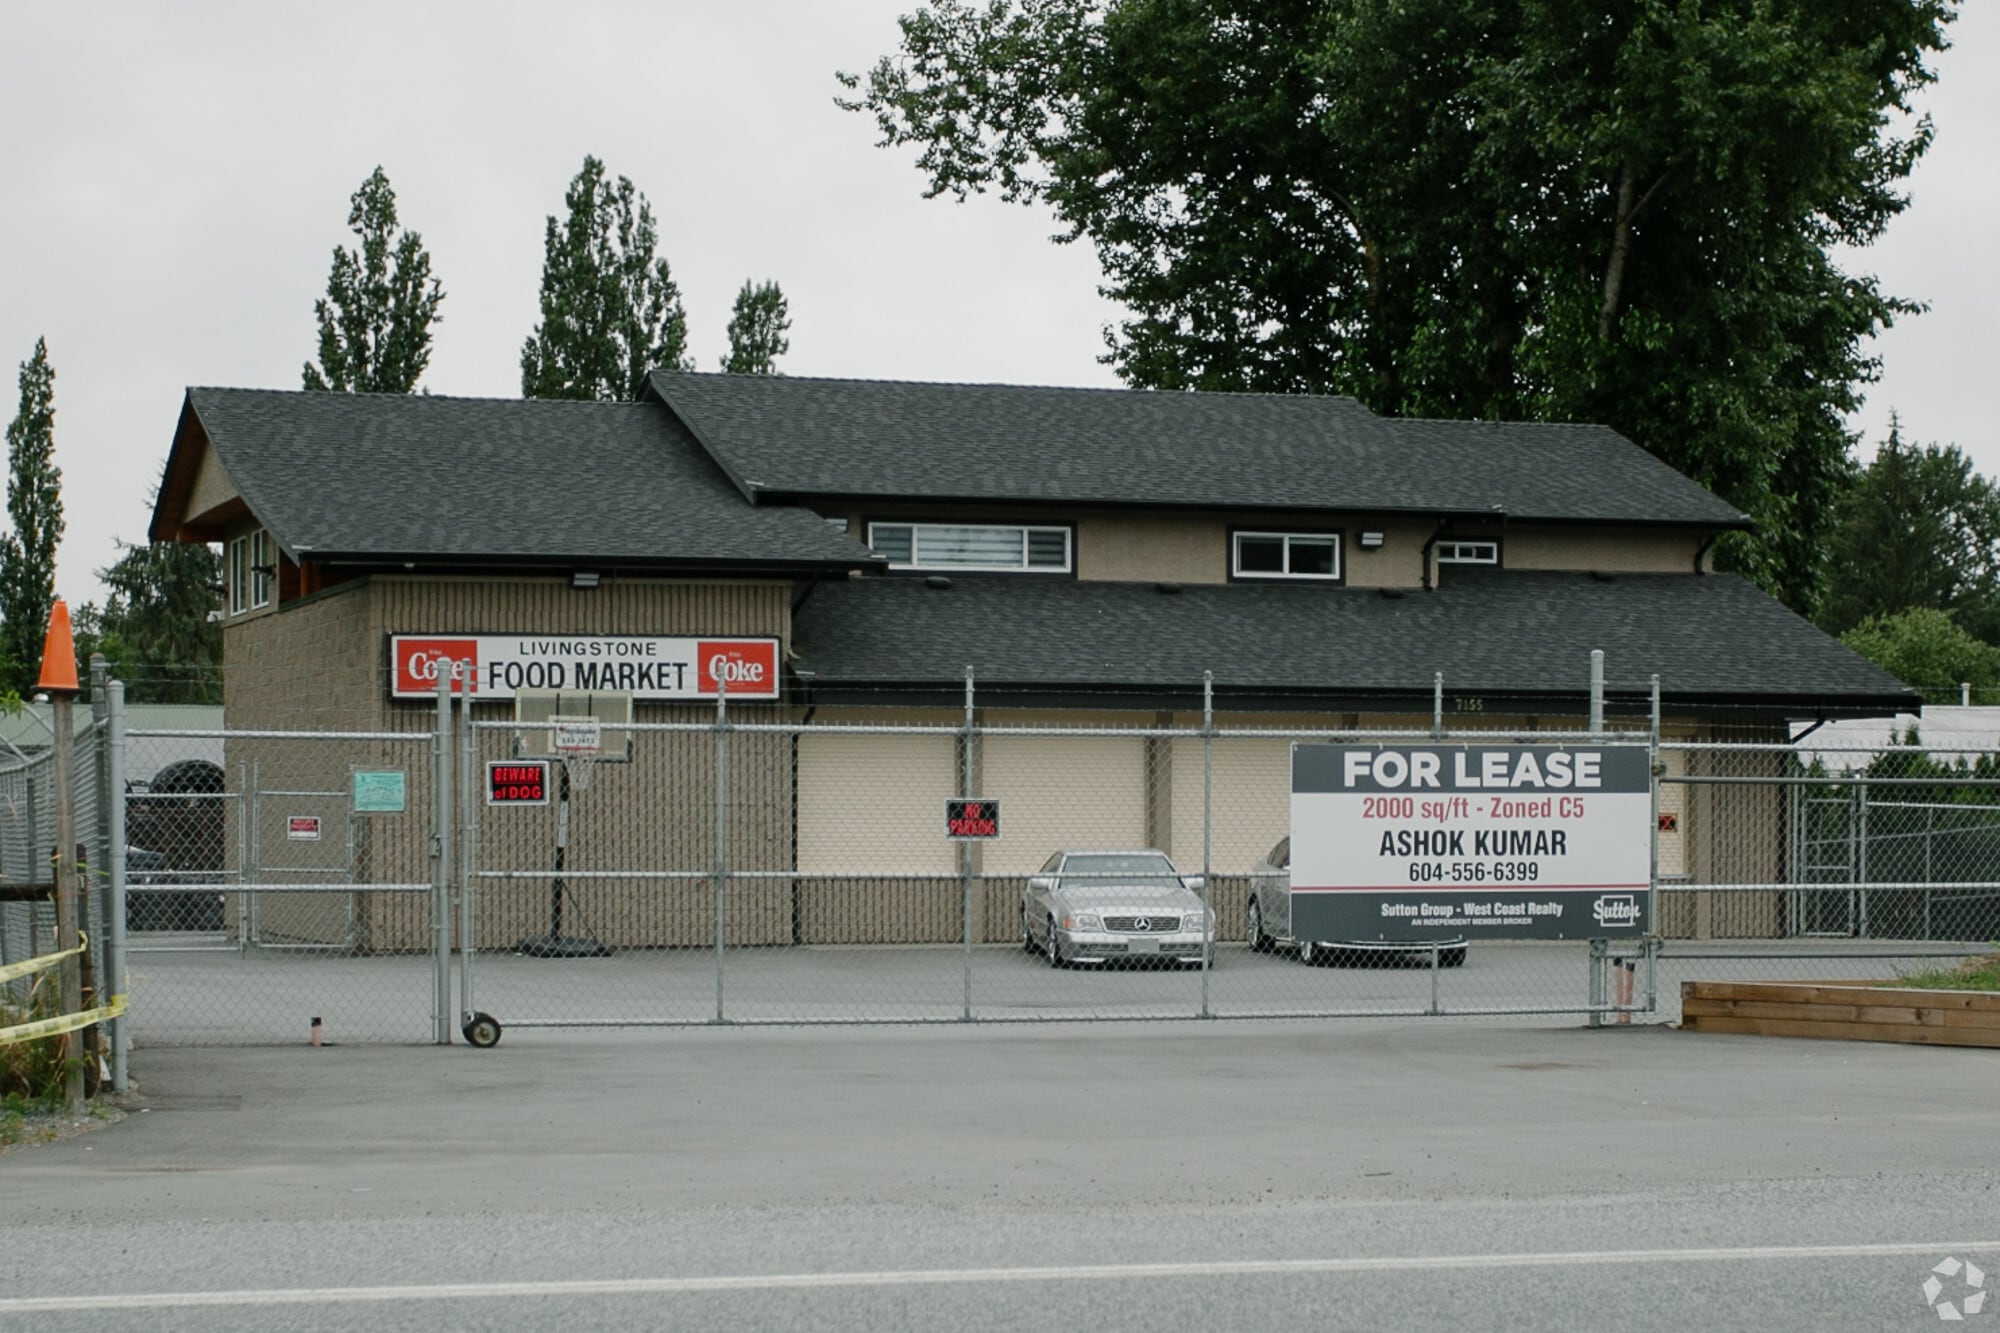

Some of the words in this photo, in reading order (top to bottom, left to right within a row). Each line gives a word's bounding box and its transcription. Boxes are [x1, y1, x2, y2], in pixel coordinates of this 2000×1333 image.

[519, 641, 657, 656] LIVINGSTONE
[489, 661, 566, 690] FOOD
[574, 661, 689, 690] MARKET
[708, 653, 764, 683] Coke
[1455, 698, 1484, 711] 7155
[494, 767, 541, 782] BEWARE
[1343, 751, 1441, 788] FOR
[1454, 751, 1602, 788] LEASE
[508, 785, 542, 799] DOG
[964, 802, 980, 819] NO
[1362, 796, 1414, 819] 2000
[1420, 796, 1469, 823] sq/ft
[1490, 796, 1552, 819] Zoned
[1558, 796, 1585, 819] C5
[949, 818, 996, 835] PARKING
[1379, 829, 1465, 857] ASHOK
[1474, 829, 1567, 857] KUMAR
[1409, 861, 1539, 882] 604-556-6399
[1381, 902, 1419, 917] Sutton
[1420, 902, 1454, 919] Group
[1463, 902, 1492, 916] West
[1493, 902, 1526, 916] Coast
[1527, 901, 1564, 918] Realty
[1592, 899, 1642, 920] Sutton
